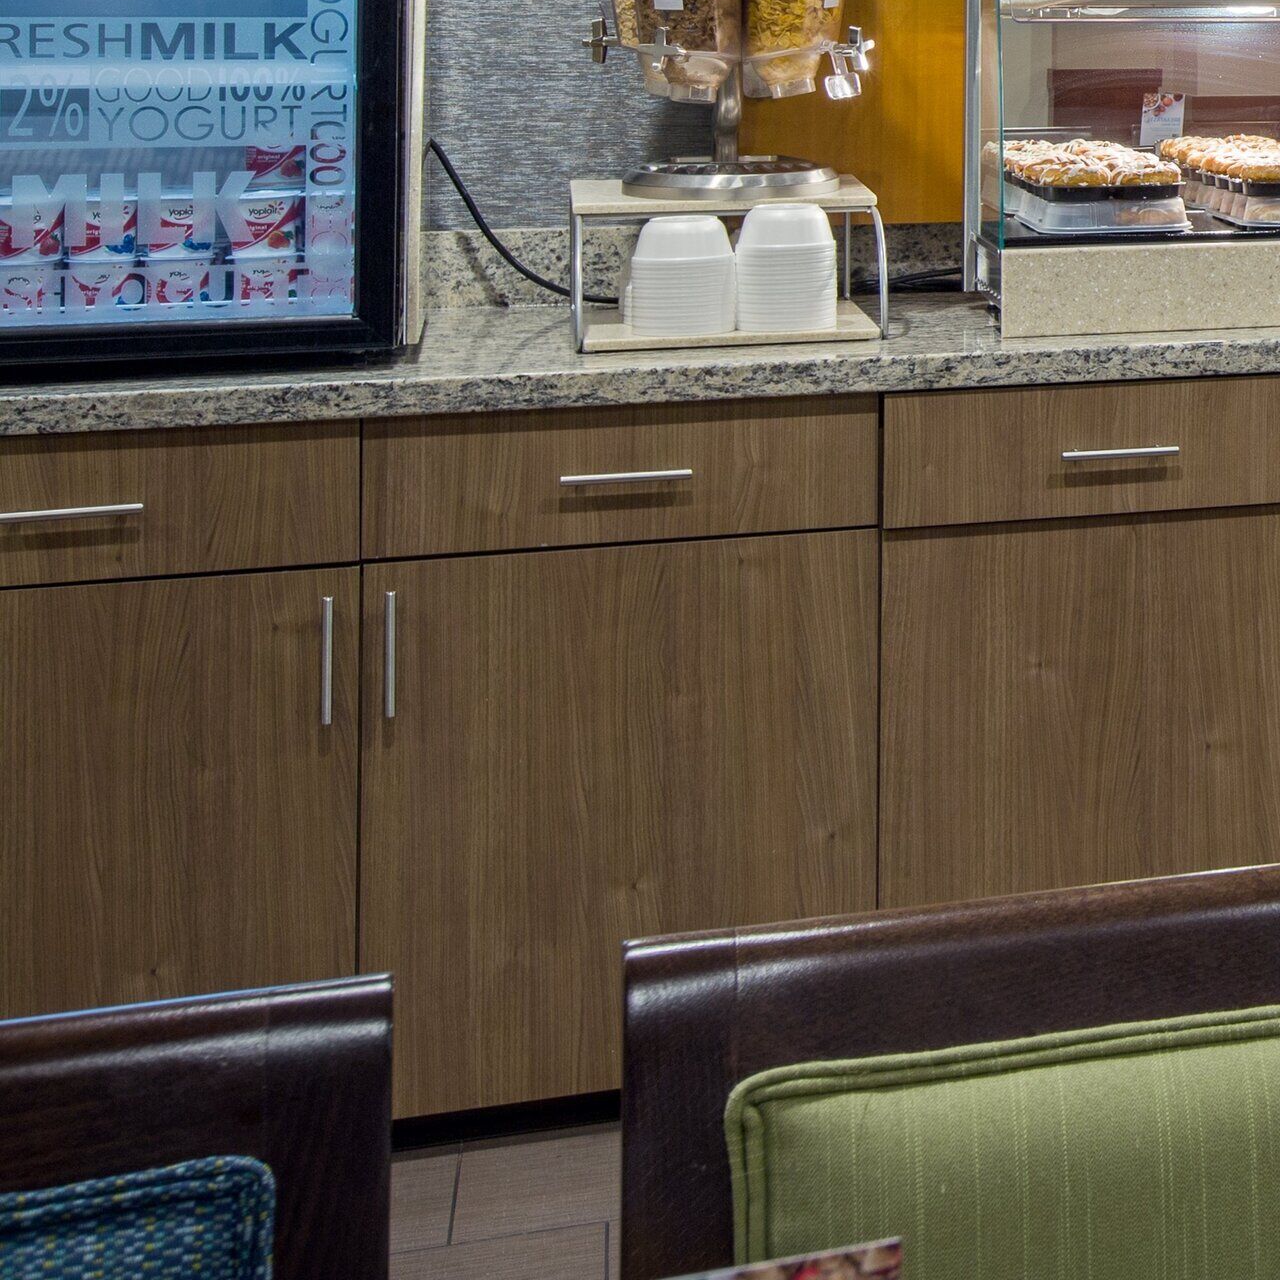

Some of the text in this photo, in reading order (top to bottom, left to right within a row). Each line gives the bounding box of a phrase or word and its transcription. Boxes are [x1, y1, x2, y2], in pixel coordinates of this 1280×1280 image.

[8, 74, 84, 138] 2%
[97, 104, 303, 142] YOGURT
[11, 170, 257, 248] MILK
